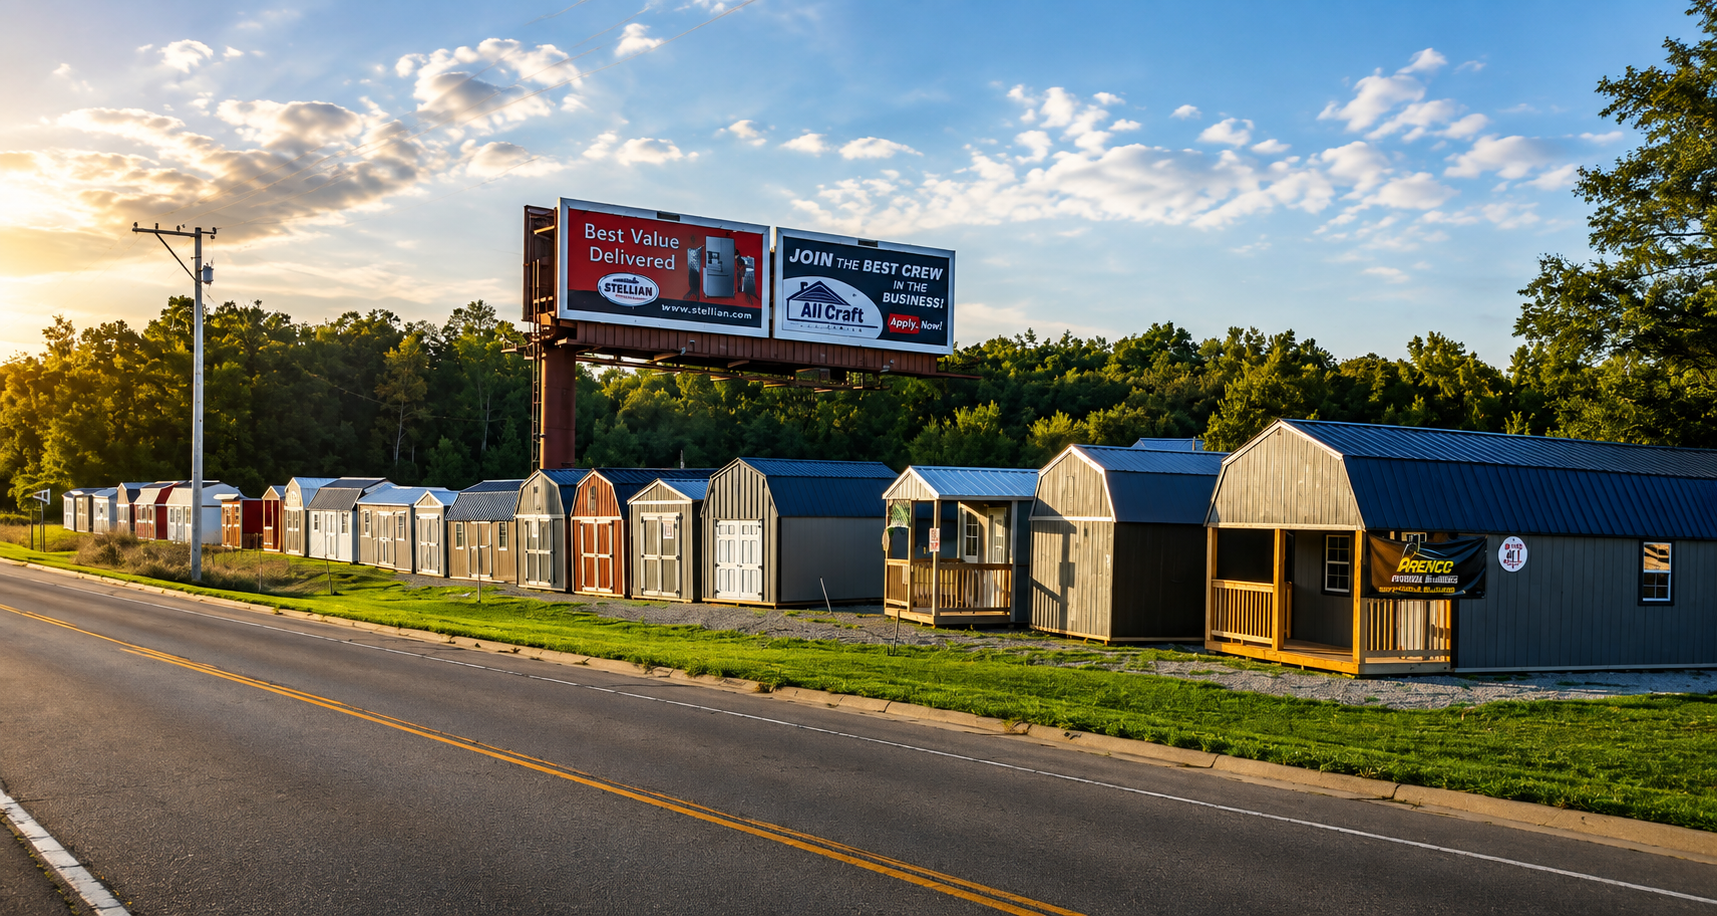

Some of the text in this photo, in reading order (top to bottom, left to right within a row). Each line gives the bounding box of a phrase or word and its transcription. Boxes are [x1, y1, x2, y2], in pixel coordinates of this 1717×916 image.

[585, 223, 680, 249] Best Value
[590, 246, 675, 270] Delivered
[789, 248, 943, 281] JOIN THE BEST CREW
[604, 282, 653, 297] STELLIAN
[893, 280, 928, 293] IN THE
[882, 292, 944, 309] BUSINESS!
[661, 303, 752, 320] www.stellian.com
[801, 302, 864, 324] All Craft
[921, 320, 943, 331] Now!
